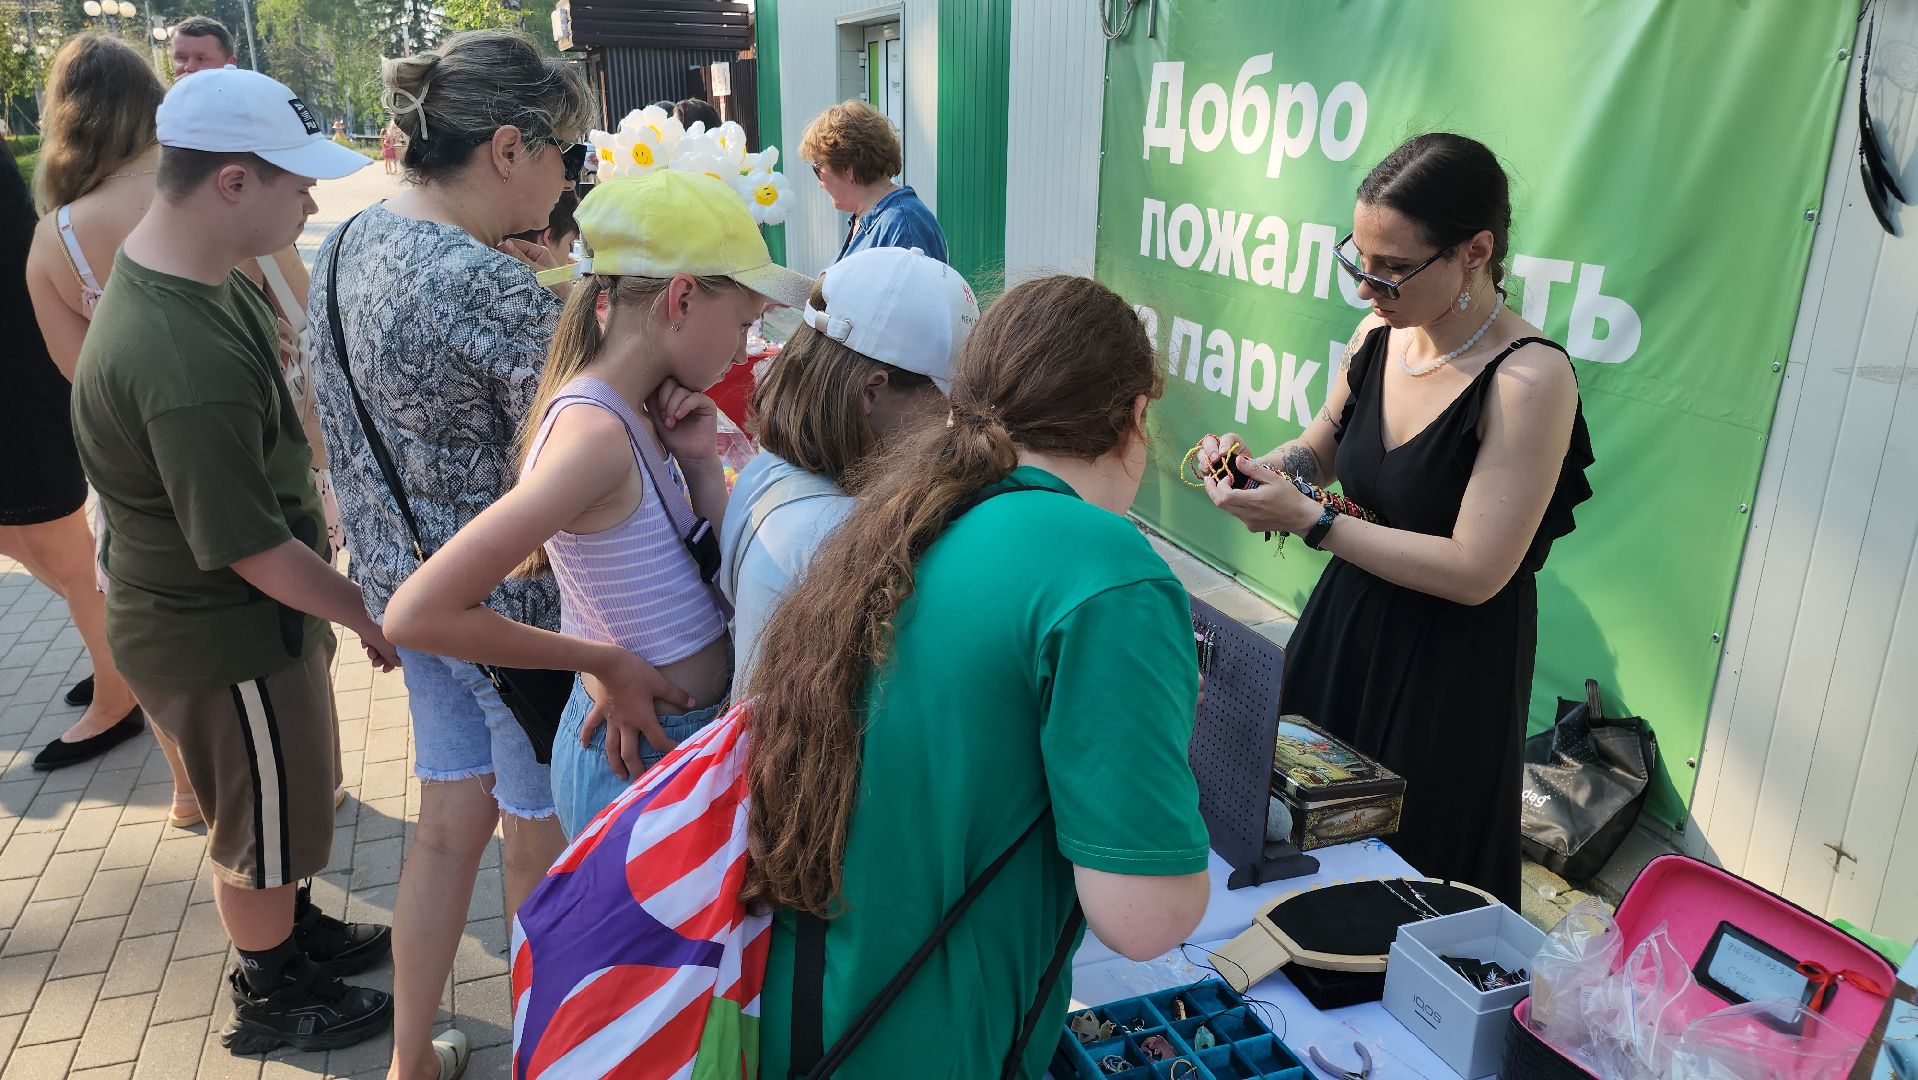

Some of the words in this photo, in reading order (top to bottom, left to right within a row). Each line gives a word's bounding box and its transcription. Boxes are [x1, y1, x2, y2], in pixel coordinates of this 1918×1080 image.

[1143, 52, 1368, 178] Добро
[1140, 197, 1641, 363] пожалть
[1413, 994, 1442, 1024] IQOS
